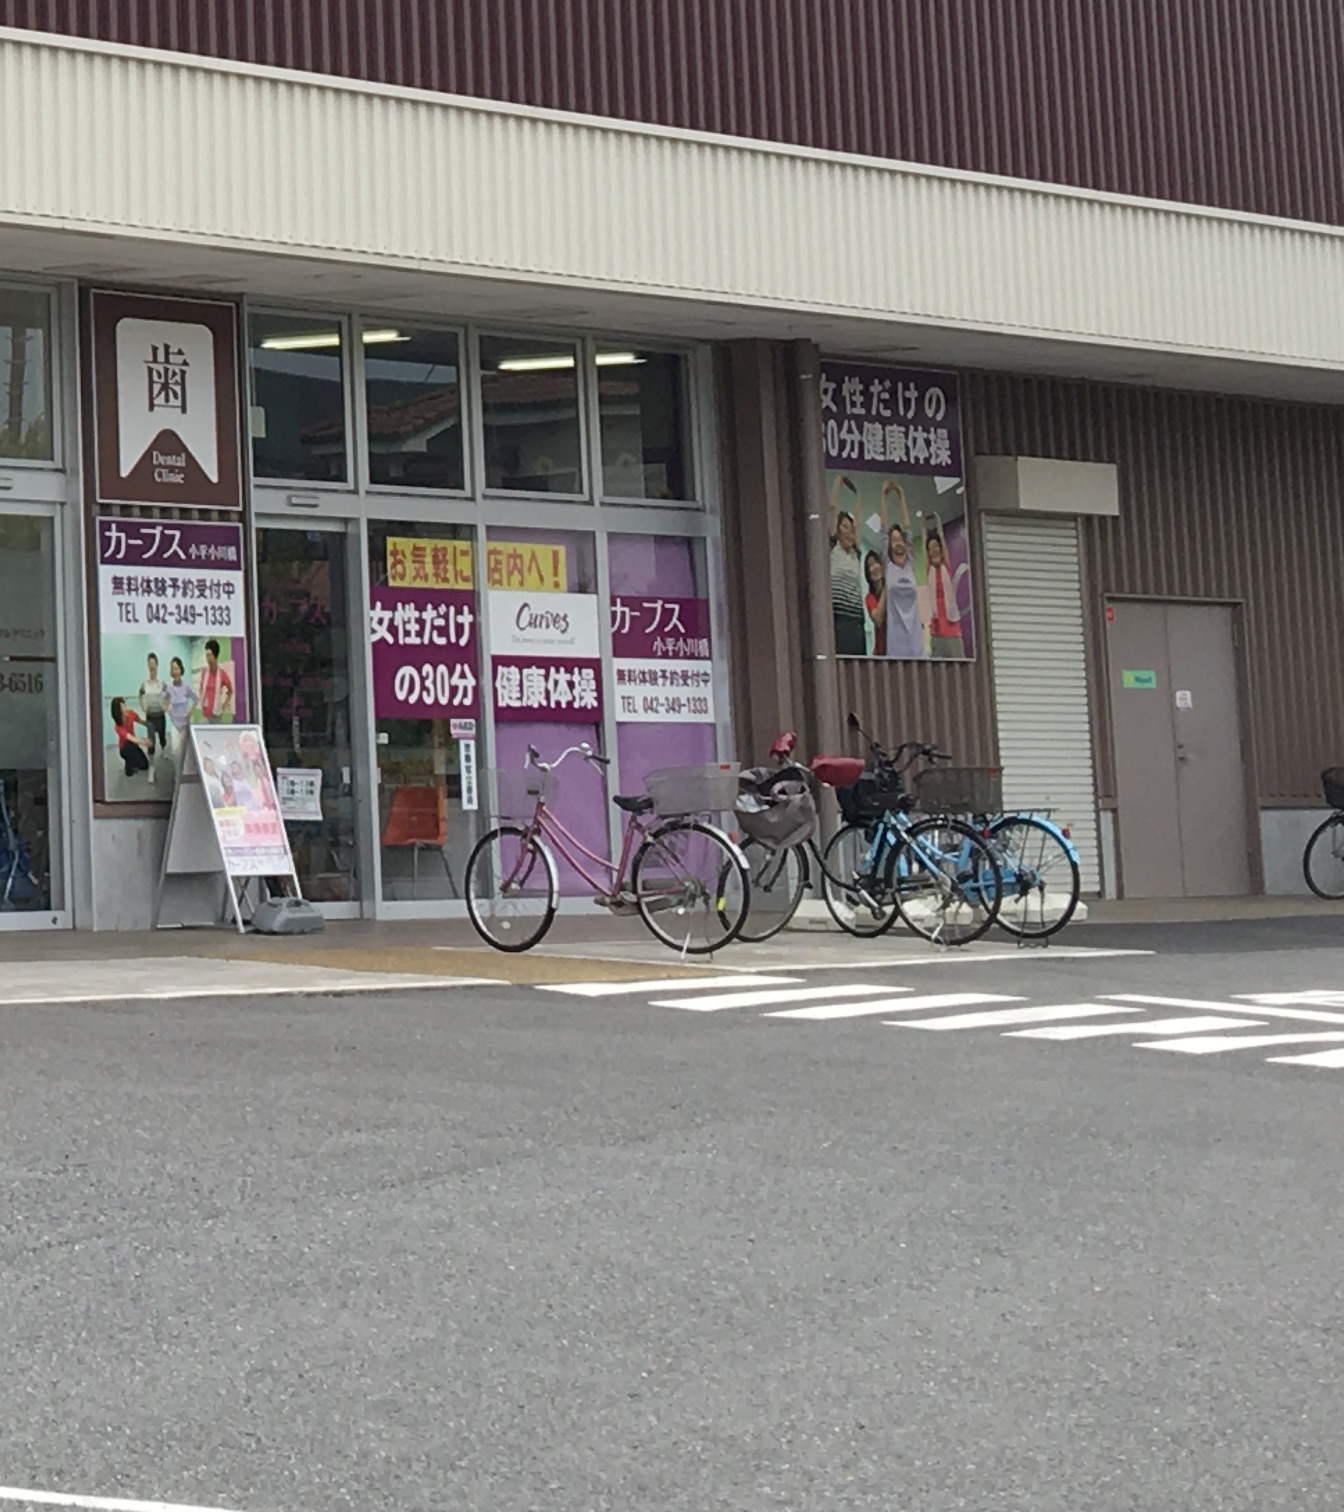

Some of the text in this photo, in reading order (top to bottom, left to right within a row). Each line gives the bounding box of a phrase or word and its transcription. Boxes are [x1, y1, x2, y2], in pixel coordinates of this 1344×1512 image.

[143, 342, 190, 415] 歯
[820, 373, 946, 422] 女性だけの
[152, 450, 186, 467] Dental
[822, 418, 952, 467] 0分健康体操
[153, 468, 185, 484] Clinic
[103, 523, 187, 560] カーブス
[389, 541, 471, 584] お気軽に
[111, 575, 236, 600] 無料体験予約受付中
[117, 601, 232, 626] TEL 042-349-1333
[370, 601, 474, 647] 女性だけ
[515, 601, 570, 634] Curves
[394, 662, 477, 706] の30分
[495, 664, 599, 710] 健康体操
[621, 695, 638, 714] TEL
